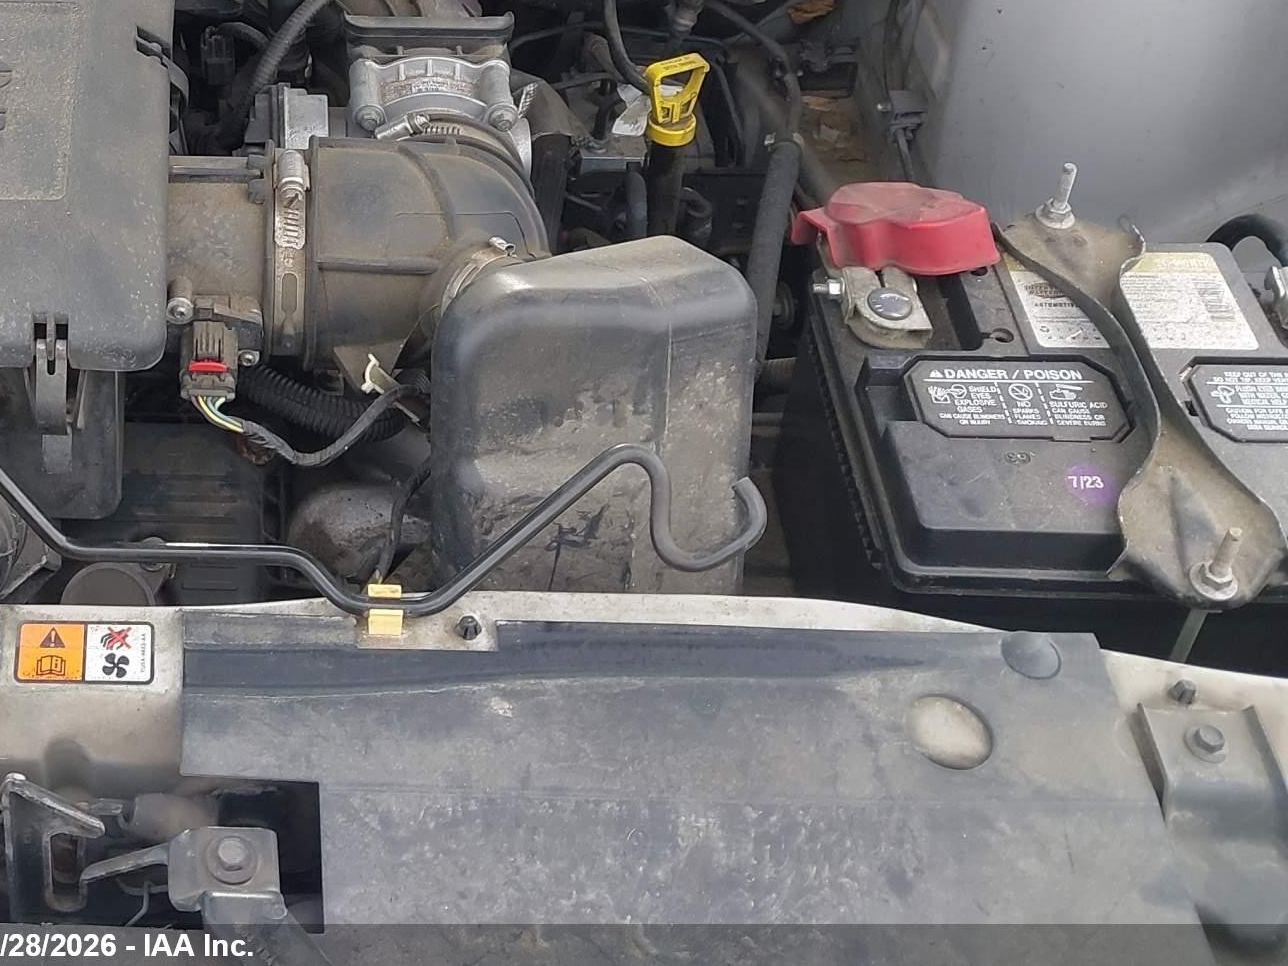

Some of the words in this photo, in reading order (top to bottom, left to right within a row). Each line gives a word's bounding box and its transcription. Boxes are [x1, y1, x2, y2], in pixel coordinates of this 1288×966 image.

[943, 369, 1009, 379] DANGER
[1012, 369, 1020, 379] /
[1023, 369, 1083, 380] POISON
[1089, 401, 1108, 409] ACID
